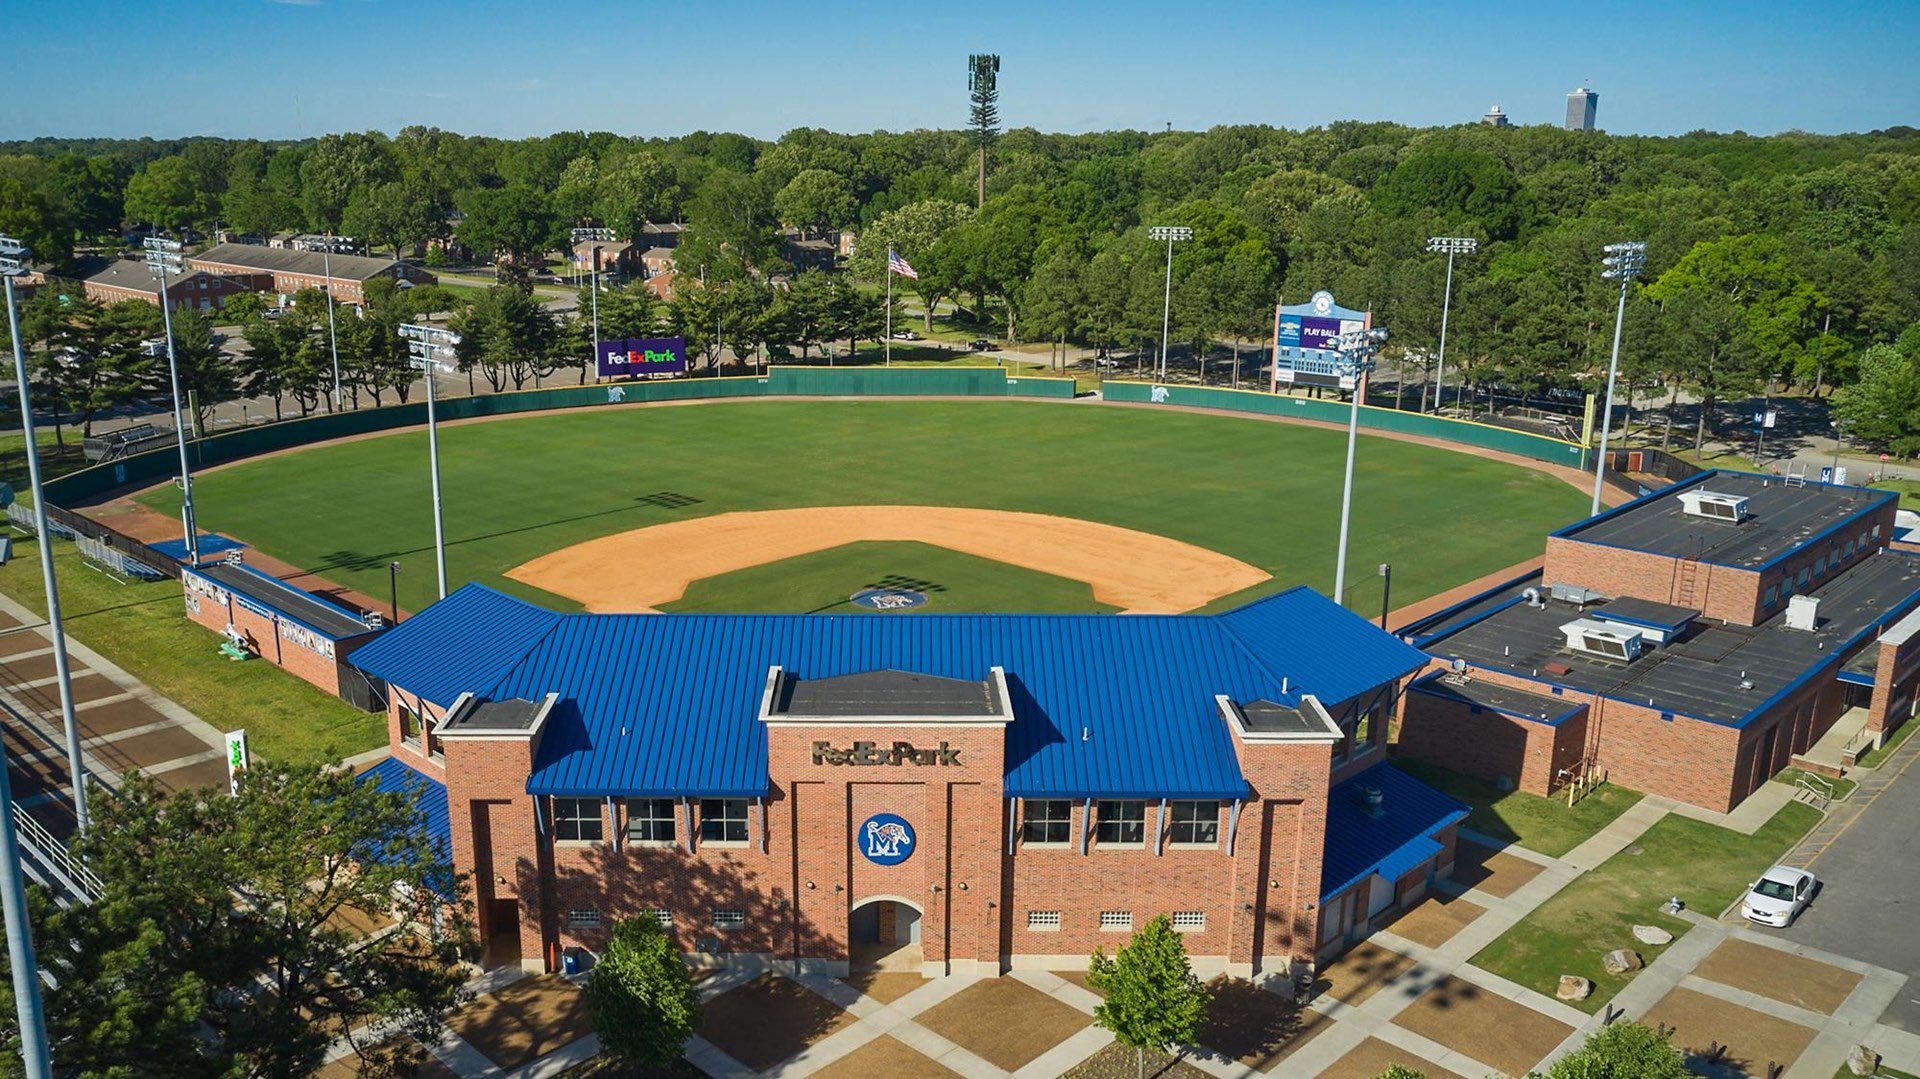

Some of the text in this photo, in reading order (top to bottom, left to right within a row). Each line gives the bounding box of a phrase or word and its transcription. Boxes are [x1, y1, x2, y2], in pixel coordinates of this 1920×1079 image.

[1304, 327, 1320, 336] PLAY
[1321, 329, 1336, 337] BALL
[1548, 387, 1583, 399] FOOTBALL
